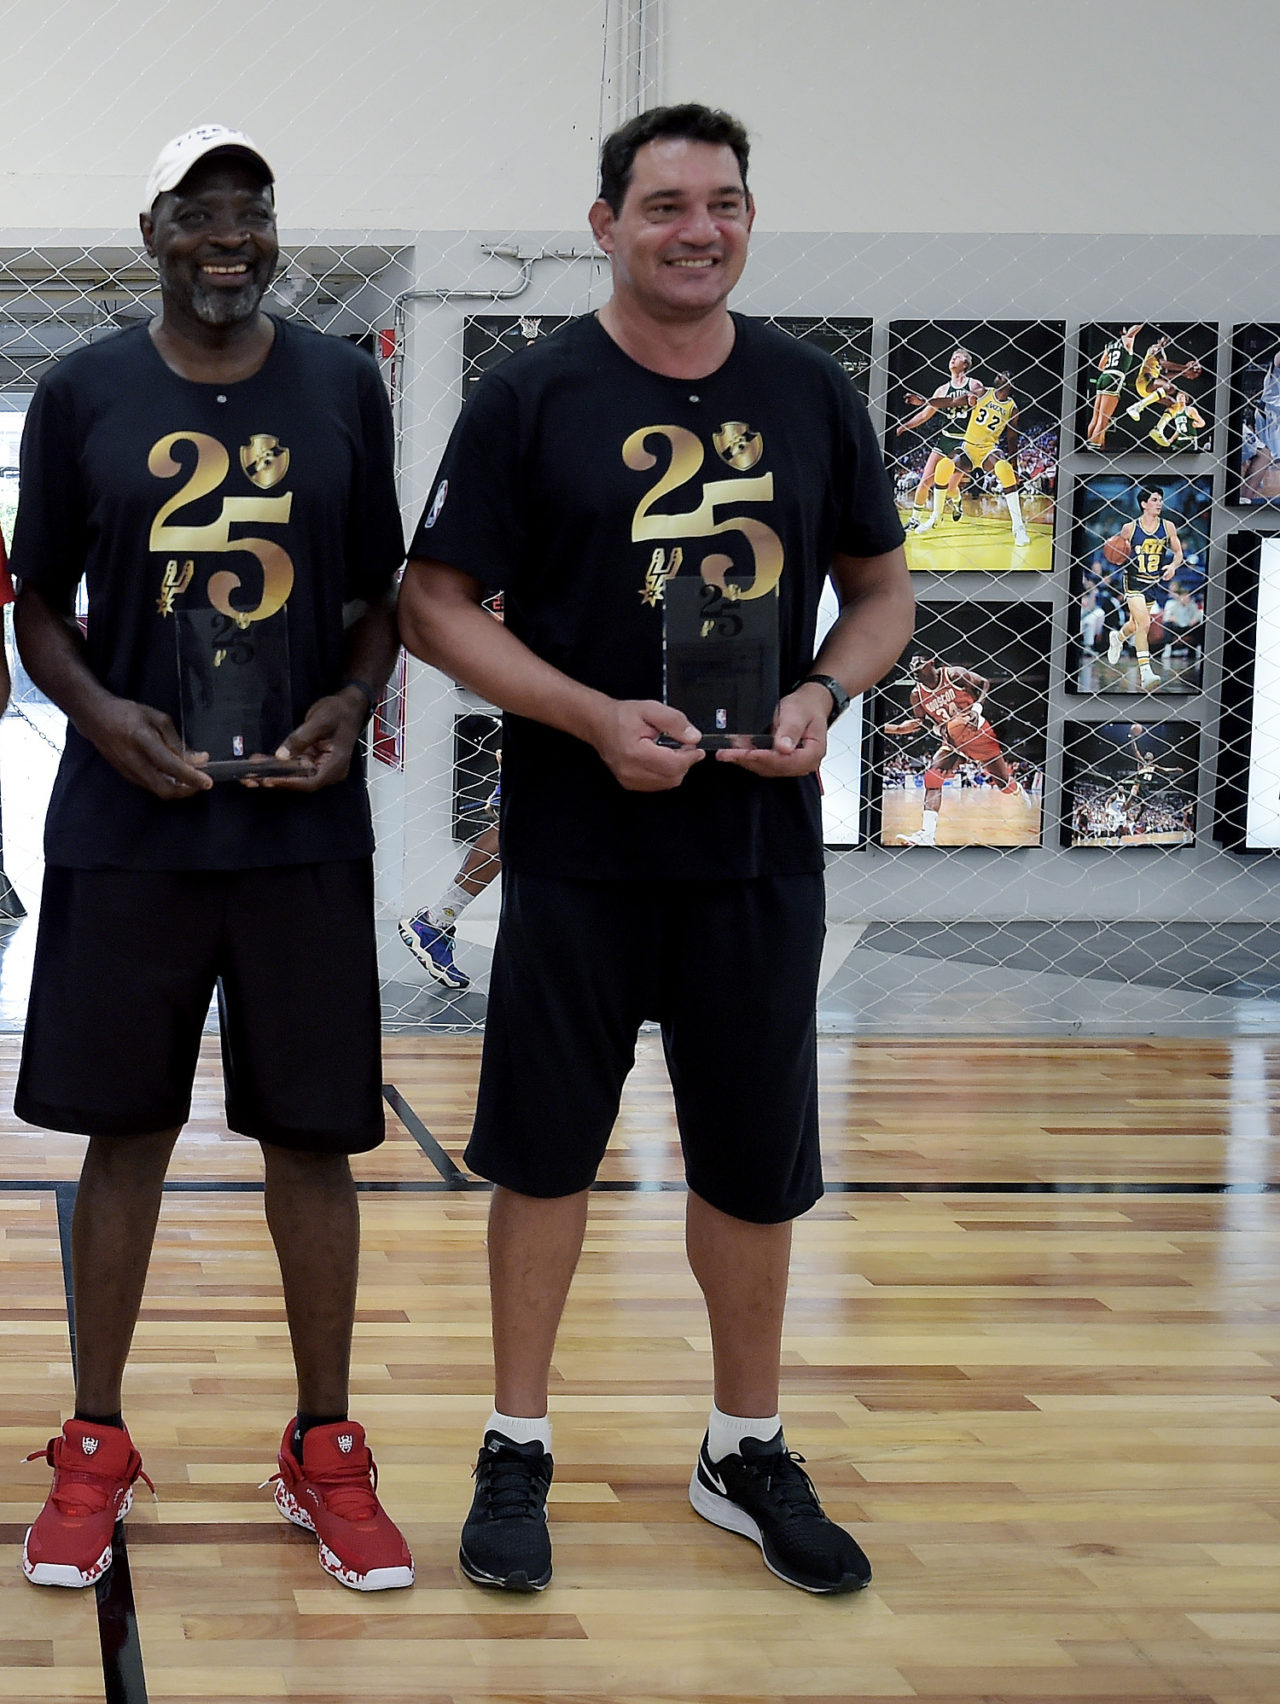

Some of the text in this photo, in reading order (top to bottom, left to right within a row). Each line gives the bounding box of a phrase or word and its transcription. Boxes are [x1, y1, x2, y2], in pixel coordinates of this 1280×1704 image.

[975, 407, 1001, 431] 32
[147, 430, 295, 622] 25
[621, 424, 785, 601] 25
[1137, 554, 1160, 573] 12
